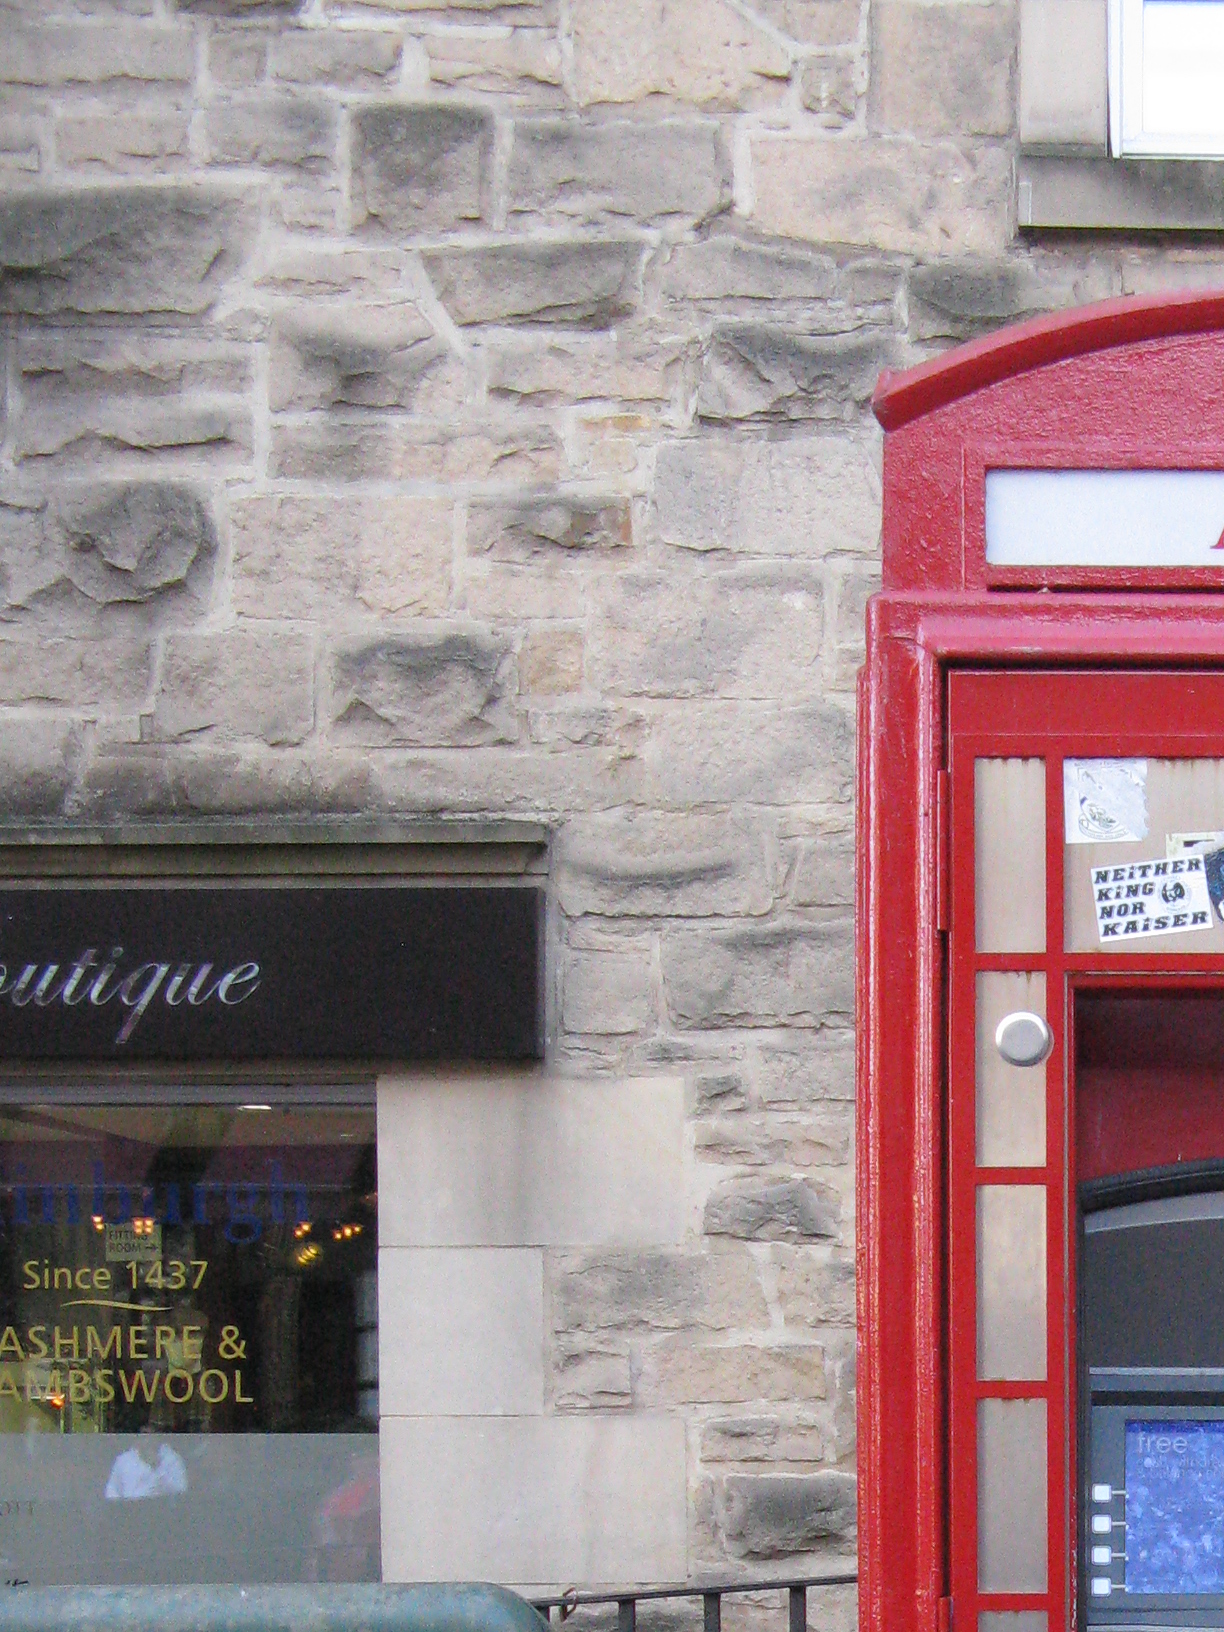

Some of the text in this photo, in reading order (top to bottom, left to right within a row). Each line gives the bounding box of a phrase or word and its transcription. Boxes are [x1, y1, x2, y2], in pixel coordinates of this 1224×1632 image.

[1099, 901, 1146, 920] NOR
[109, 1242, 141, 1253] ROOM
[23, 1260, 208, 1290] Since 1437
[0, 1324, 247, 1360] ASHMERE &
[1137, 1432, 1188, 1454] free
